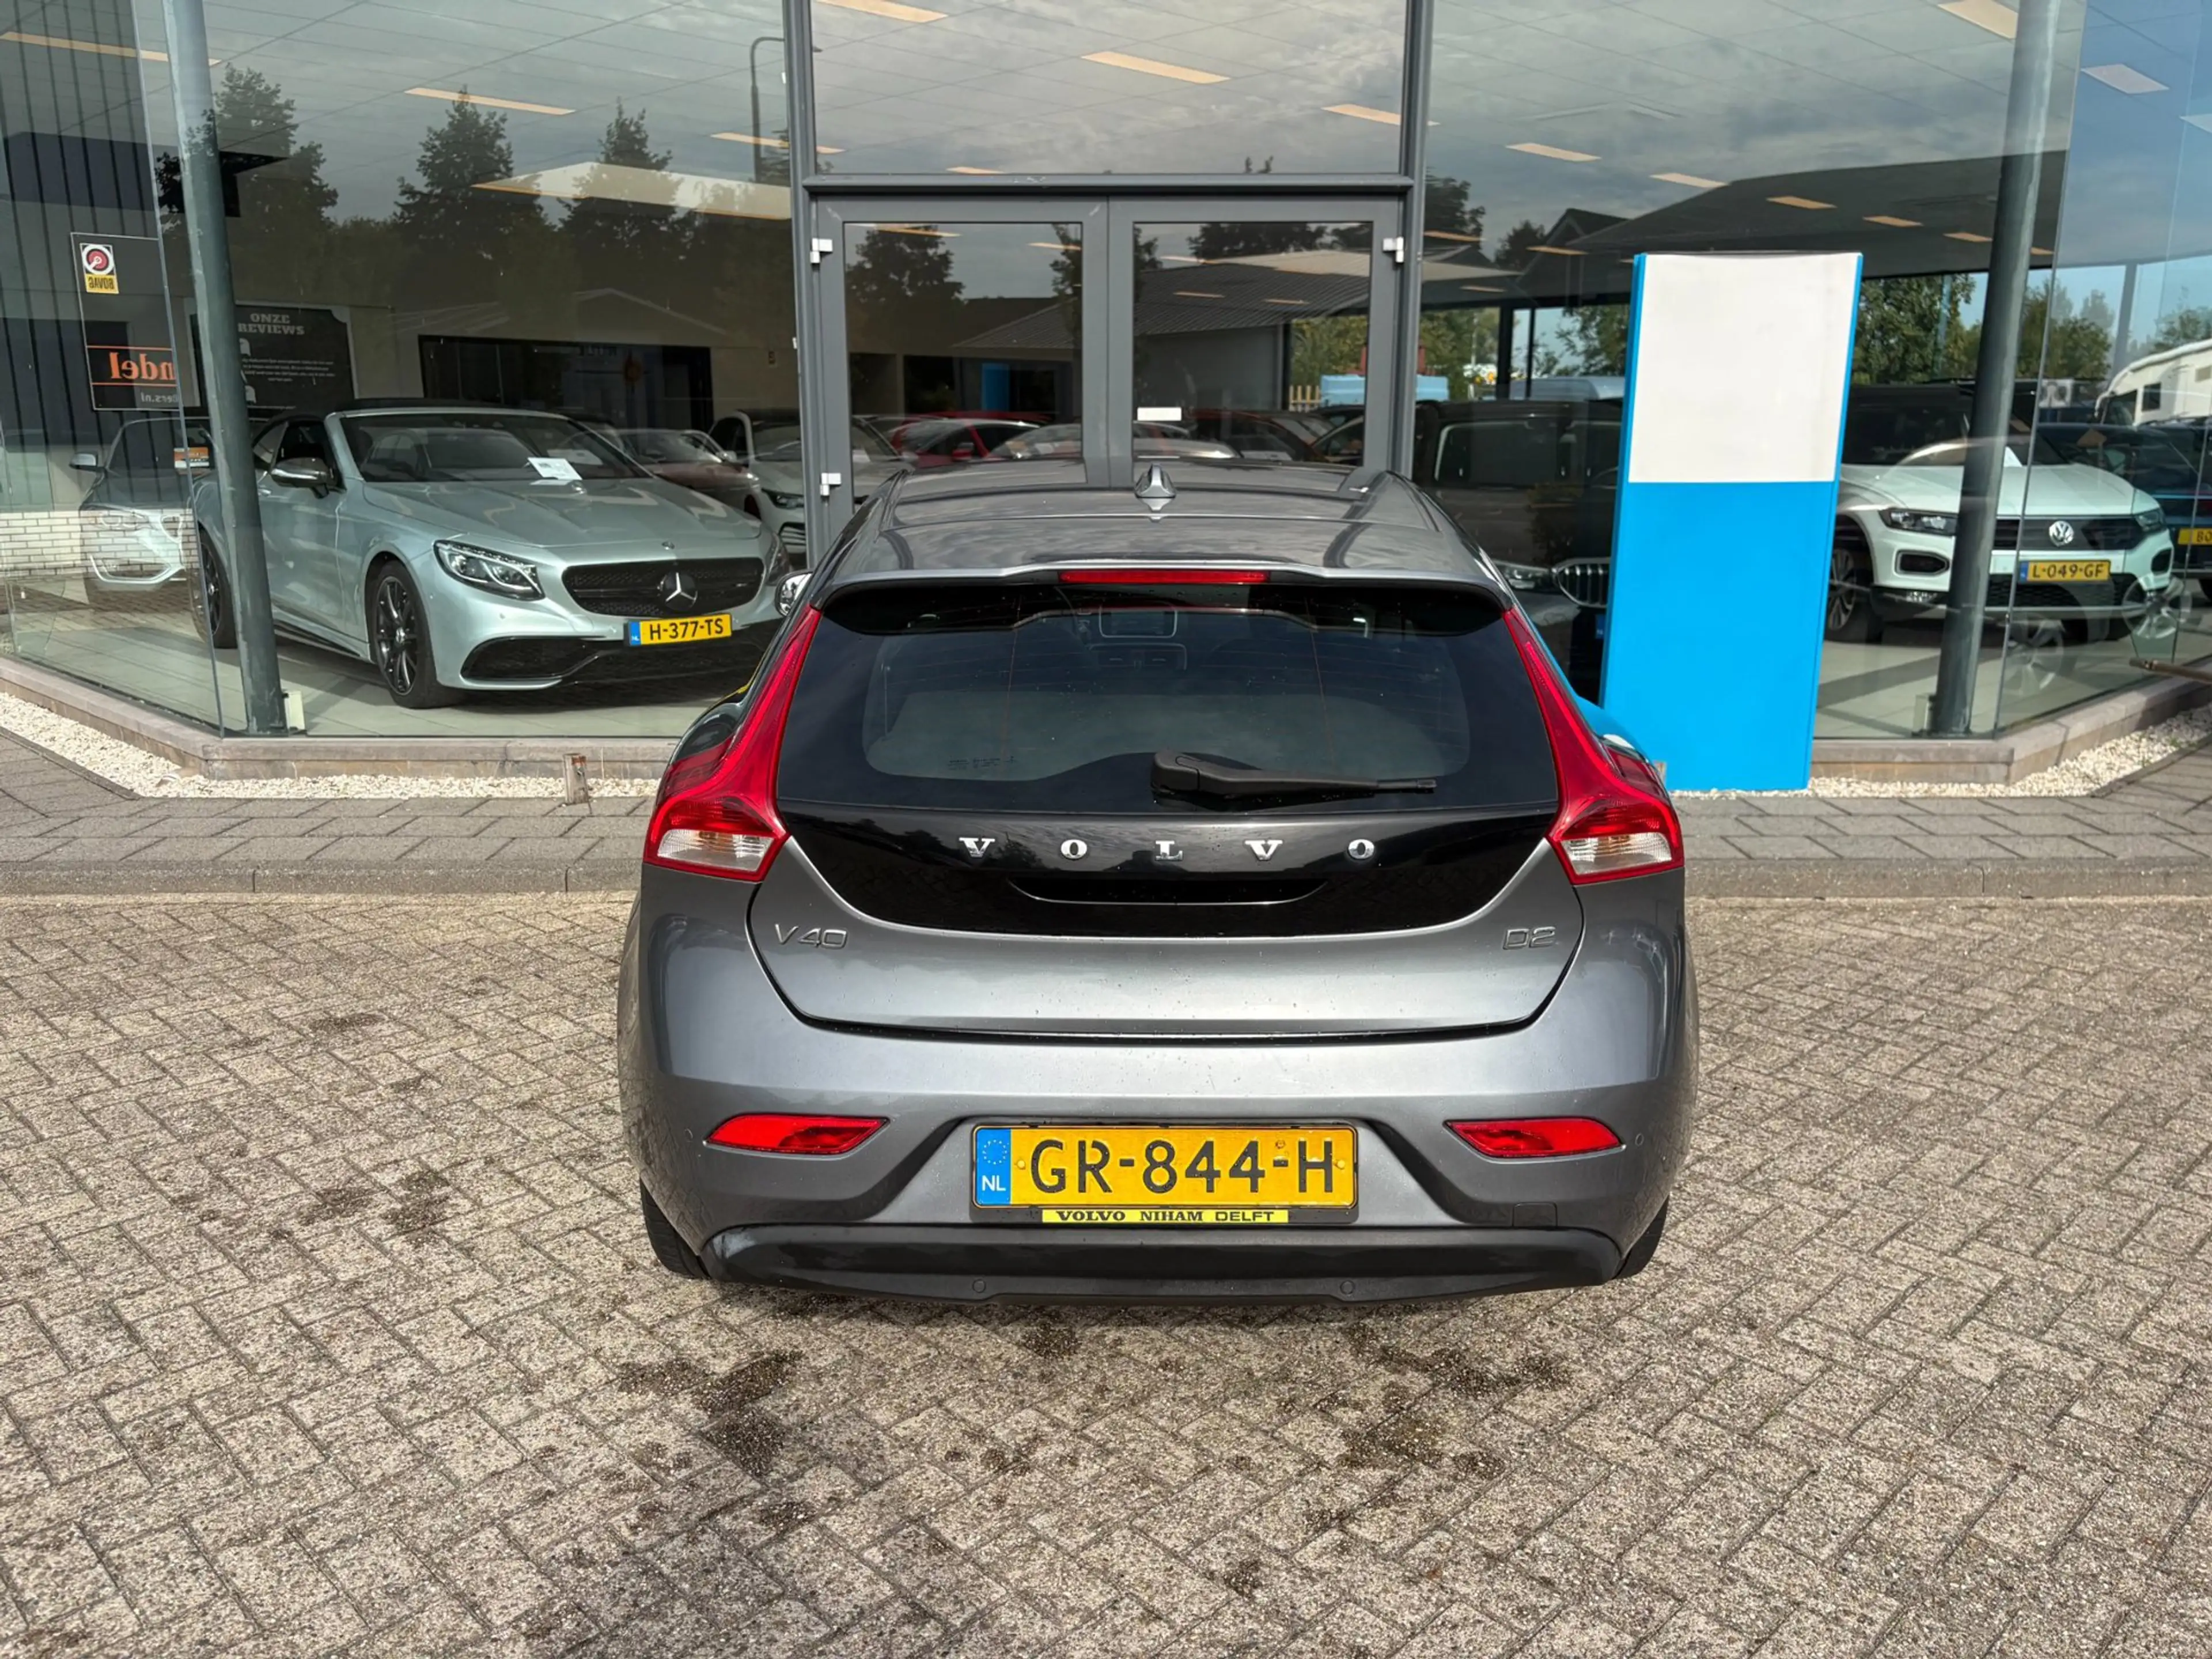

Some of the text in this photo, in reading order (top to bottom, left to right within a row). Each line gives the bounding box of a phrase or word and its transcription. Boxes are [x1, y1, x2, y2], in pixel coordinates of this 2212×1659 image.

[238, 323, 305, 335] REVIEWS
[250, 313, 290, 324] ONZE
[2032, 563, 2106, 579] L-049-GF
[650, 618, 724, 641] H-377-TS
[959, 836, 1376, 862] VOLVO
[775, 924, 847, 949] V40
[1502, 926, 1555, 950] D2
[982, 1139, 1334, 1195] NL GR-844-H
[1056, 1210, 1275, 1222] VOLVO NIHAM DELFT
